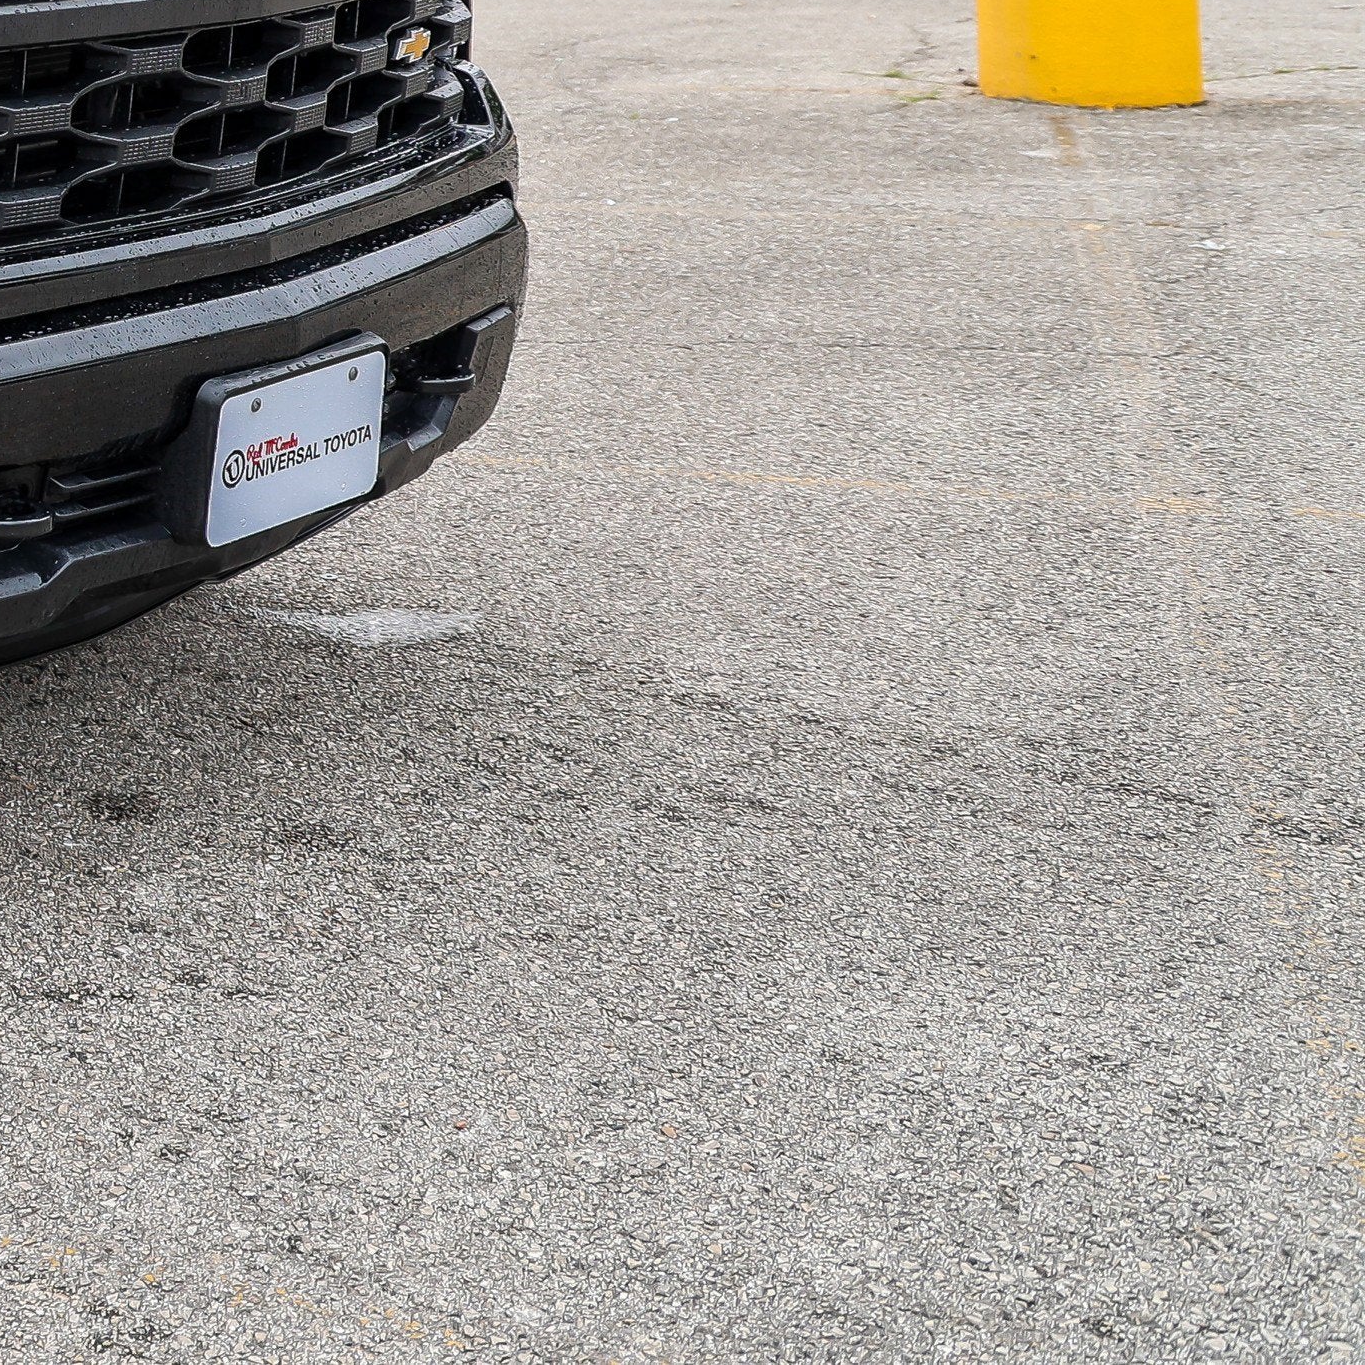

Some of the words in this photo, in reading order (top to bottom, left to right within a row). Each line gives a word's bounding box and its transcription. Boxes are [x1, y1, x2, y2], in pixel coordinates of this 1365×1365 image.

[245, 442, 321, 482] UNIVERSAL
[323, 424, 373, 456] TOYOTA
[246, 440, 264, 466] Red
